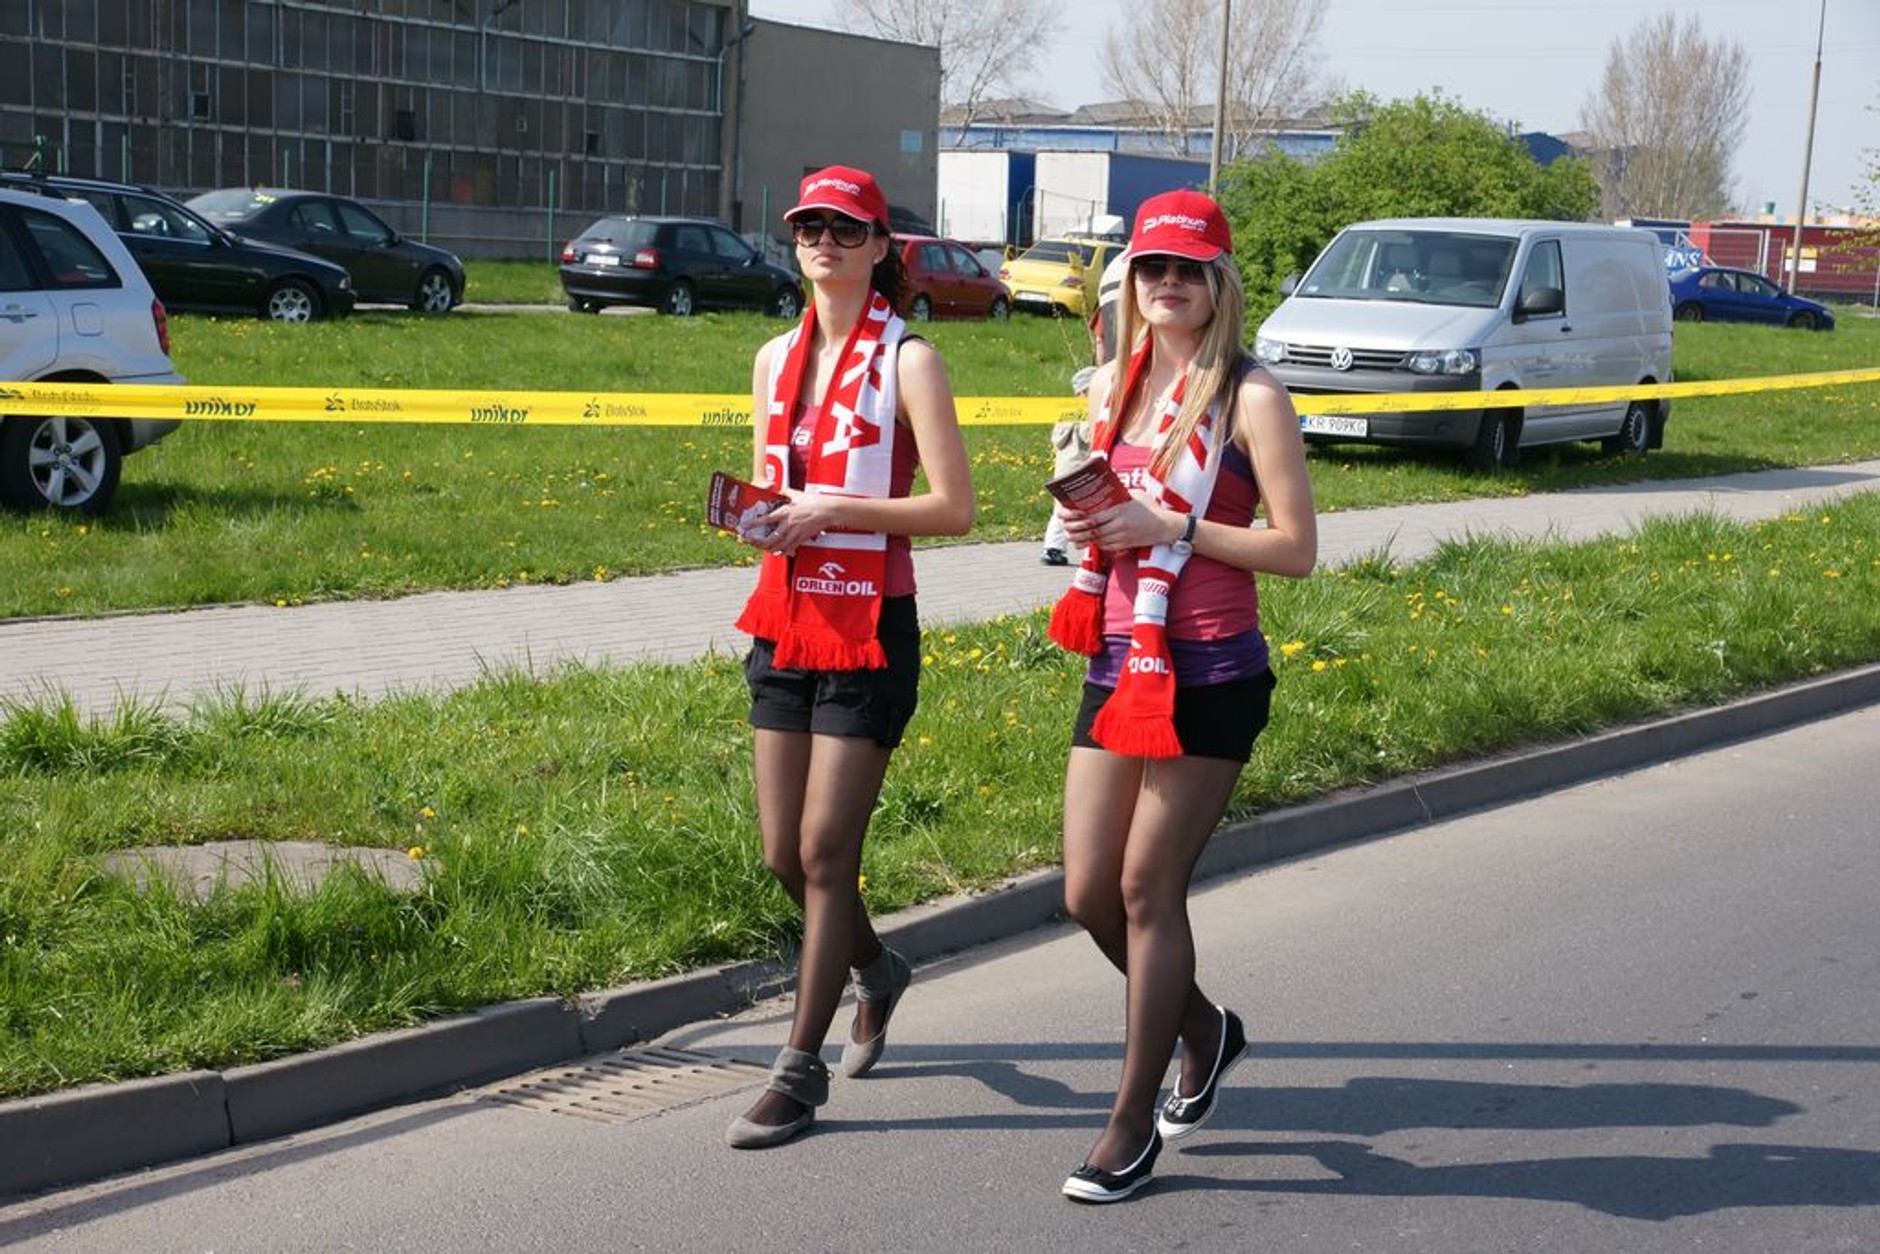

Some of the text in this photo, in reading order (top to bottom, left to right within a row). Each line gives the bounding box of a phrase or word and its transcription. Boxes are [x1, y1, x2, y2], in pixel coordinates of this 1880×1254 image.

[702, 408, 751, 425] unikor
[797, 578, 877, 596] ORLEN OIL
